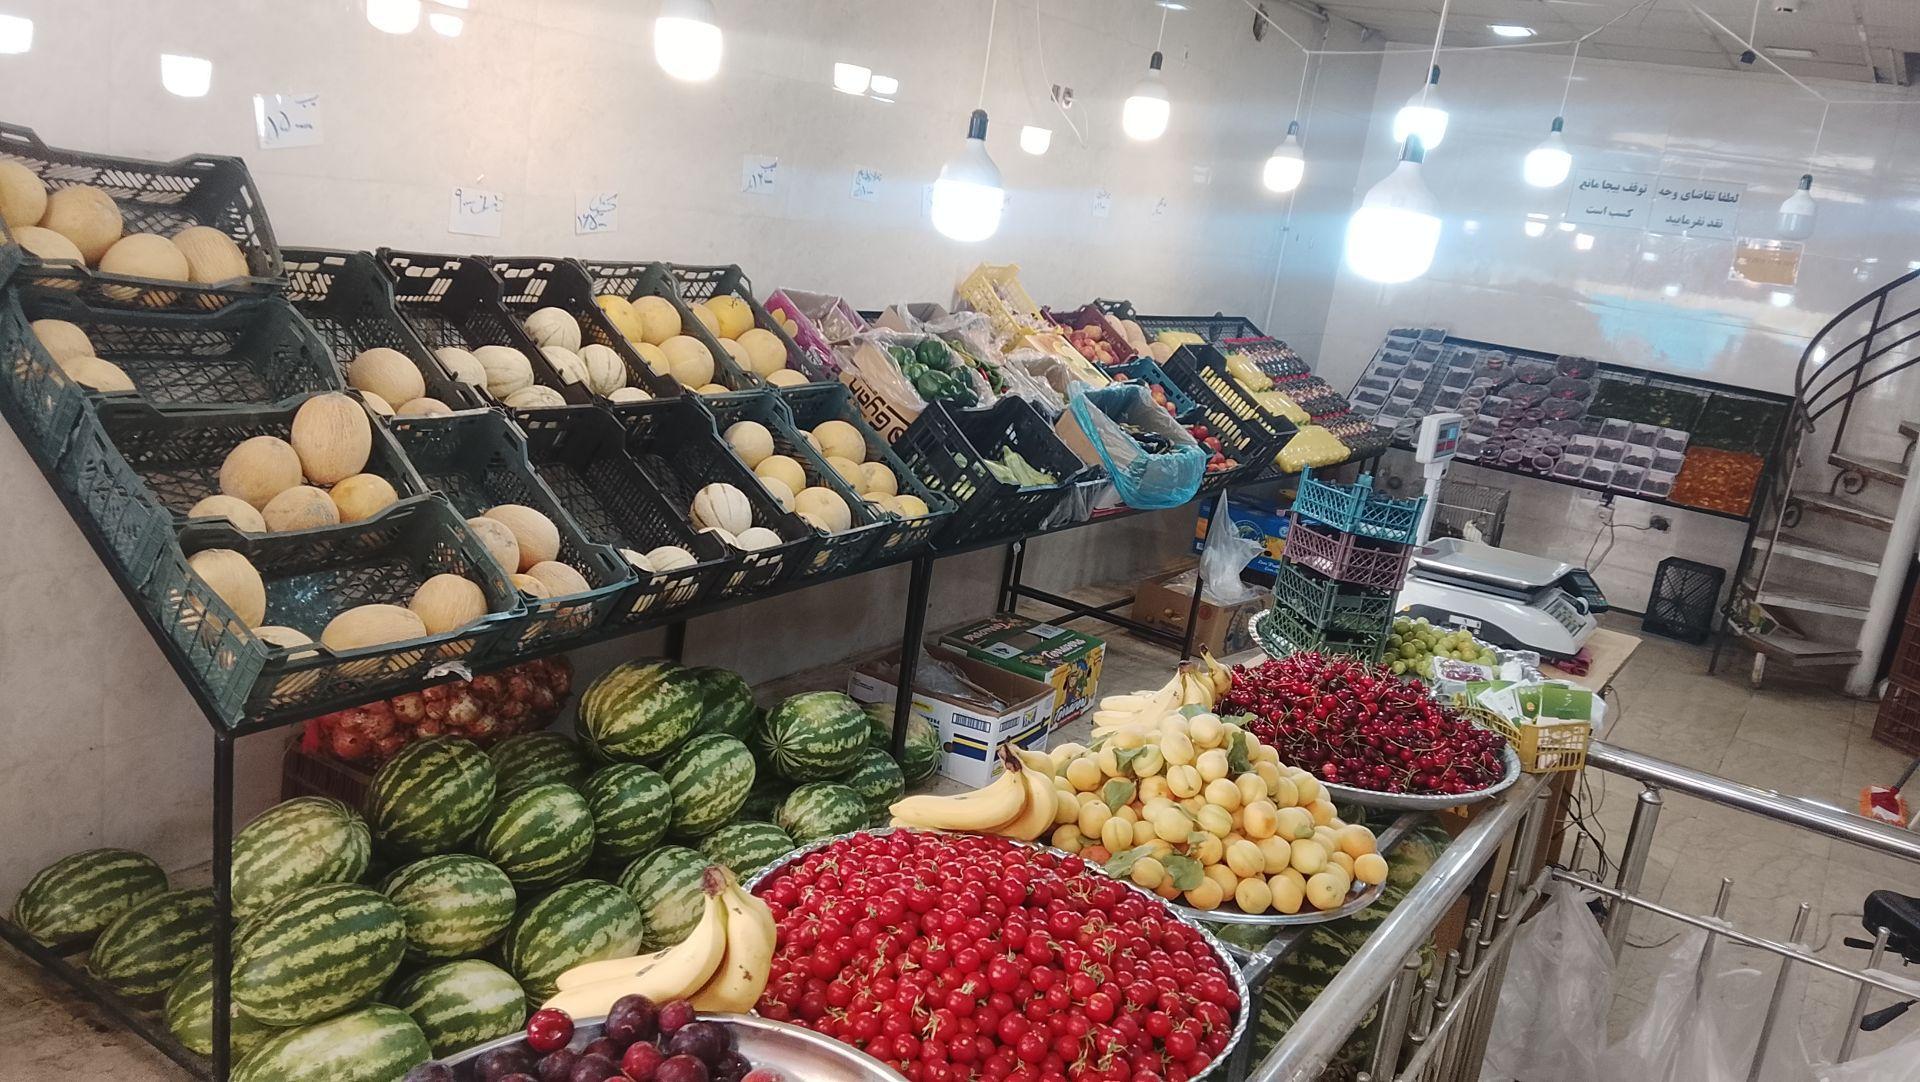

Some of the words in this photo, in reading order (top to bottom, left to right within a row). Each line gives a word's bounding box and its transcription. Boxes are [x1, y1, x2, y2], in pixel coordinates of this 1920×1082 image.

[1579, 179, 1600, 191] مانع
[1602, 180, 1620, 193] بیجا
[1622, 182, 1648, 196] توقف
[1680, 188, 1716, 201] تقاضای
[1718, 191, 1739, 203] لطفا
[1585, 206, 1608, 215] است
[1608, 208, 1634, 219] کسب
[1706, 218, 1724, 228] نقد
[848, 377, 892, 432] Gyan
